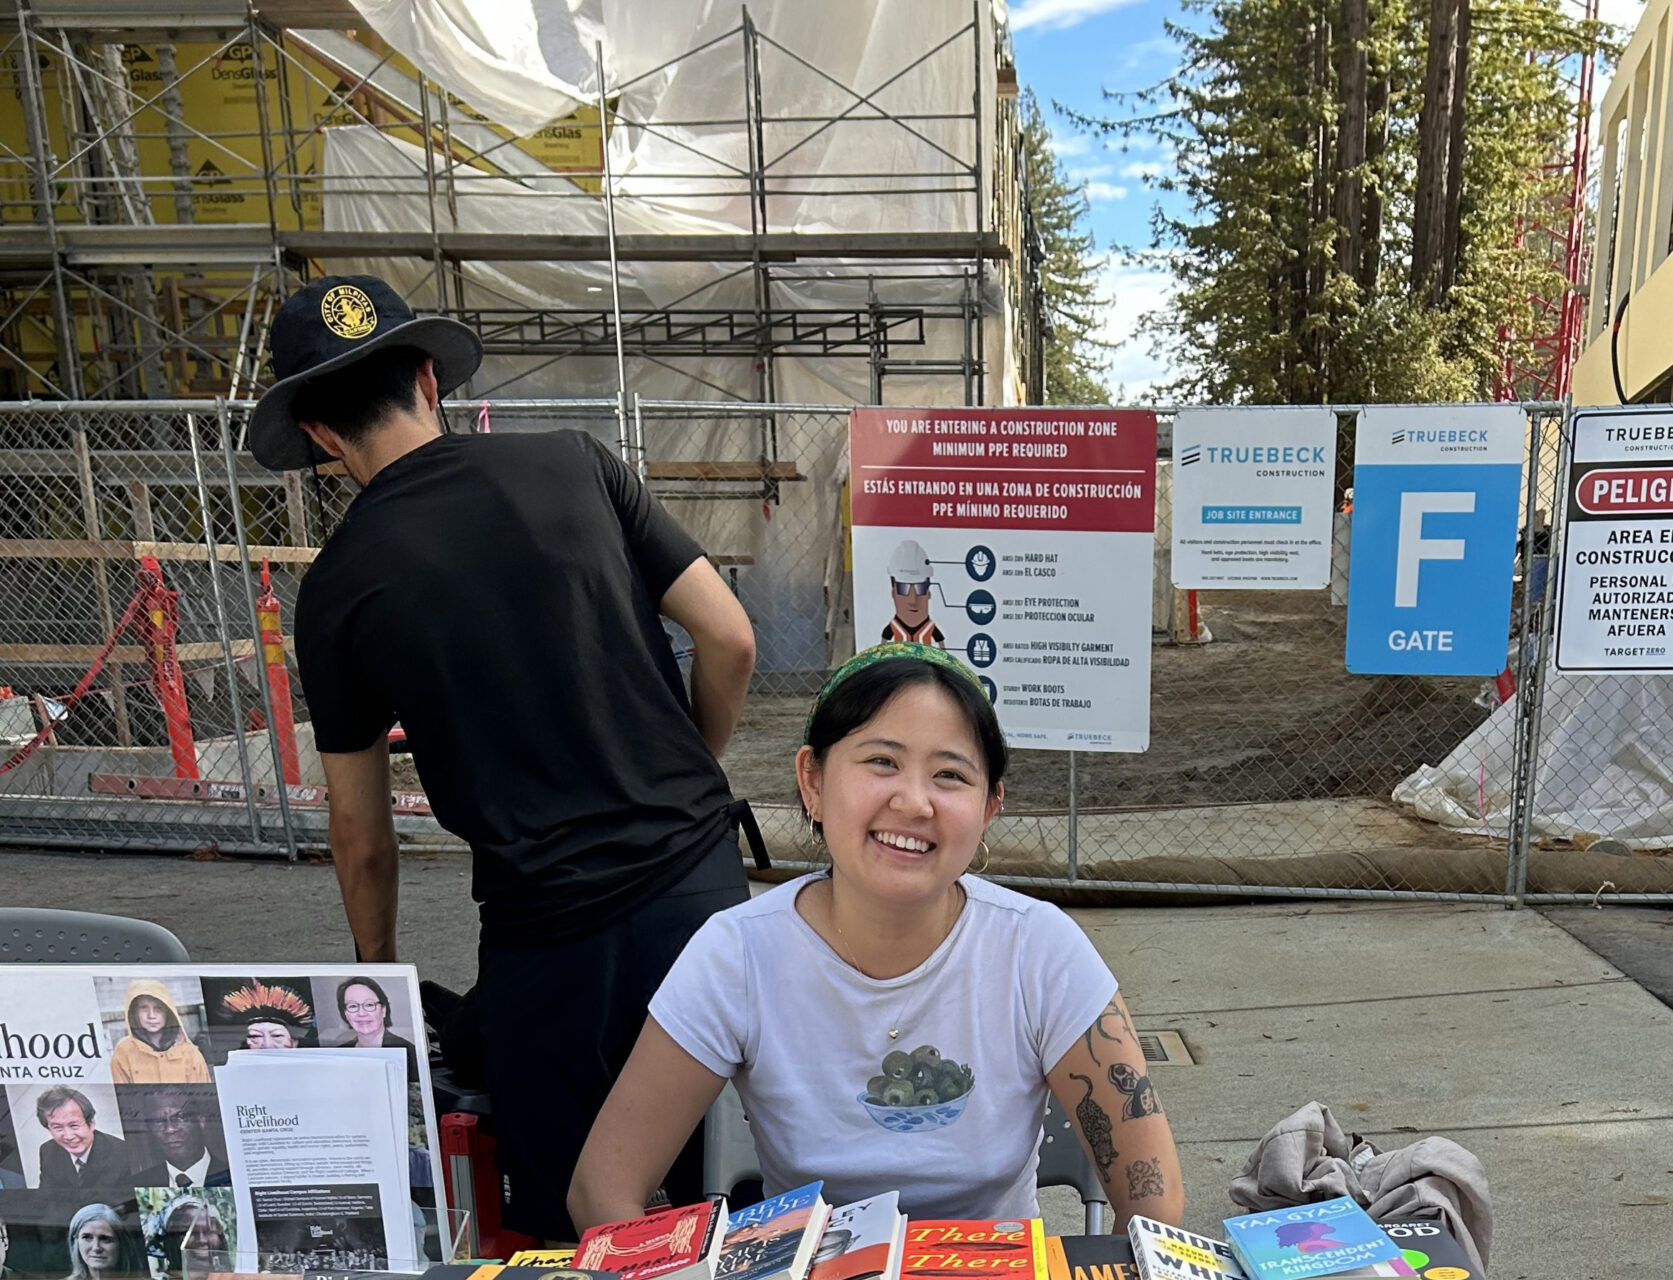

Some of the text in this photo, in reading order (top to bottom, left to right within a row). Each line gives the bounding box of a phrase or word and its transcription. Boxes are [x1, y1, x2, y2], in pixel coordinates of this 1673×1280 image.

[229, 46, 252, 58] GP
[325, 303, 334, 323] CITY
[338, 288, 372, 312] MILPITAS
[886, 419, 1117, 437] YOU ARE ENTERING A CONSTRUCTION ZONE
[1408, 430, 1488, 443] TRUEBECK
[933, 442, 1068, 458] MINIMUM PPE REQUIRED
[1207, 447, 1325, 463] TRUEBECK
[864, 477, 1142, 499] ESTÁS ENTRANDO EN UNA ZONA DE CONSTRUCCIÓN
[1592, 477, 1673, 504] PELIG
[932, 500, 1068, 519] PPE MÍNIMO REQUERIDO
[1206, 510, 1297, 520] JOB SITE ENTRANCE
[1607, 530, 1653, 544] AREA
[1395, 491, 1476, 608] F
[1025, 553, 1058, 563] HARD HAT
[1025, 567, 1056, 577] EL CASCO
[1589, 576, 1667, 588] PERSONAL
[1024, 597, 1080, 608] EYE PROTECTION
[1592, 592, 1673, 604] AUTORIZAD
[1024, 611, 1095, 622] PROTECCION OCULAR
[1607, 624, 1666, 637] AFUERA
[1030, 641, 1047, 651] HIGH
[1081, 643, 1114, 653] GARMENT
[1388, 630, 1453, 651] GATE
[1604, 647, 1666, 656] TARGET ZERO
[1043, 655, 1130, 667] ROPA DE ALTA VISIBILIDAD
[1022, 683, 1065, 694] WORK BOOTS
[1030, 697, 1092, 709] BOTAS DE TRABAJO
[1074, 733, 1112, 741] TRUEBECK
[0, 1022, 102, 1060] hood
[38, 1065, 85, 1079] CRUZ
[236, 1104, 268, 1119] Right
[237, 1114, 299, 1129] Livelihood
[1232, 1216, 1281, 1230] YAA
[1286, 1201, 1354, 1221] GYASI
[907, 1226, 1026, 1242] There
[1141, 1219, 1234, 1260] UNDE
[905, 1253, 1029, 1269] There
[1258, 1238, 1387, 1271] TRANSCENDENT
[1282, 1251, 1377, 1275] KINGDOM
